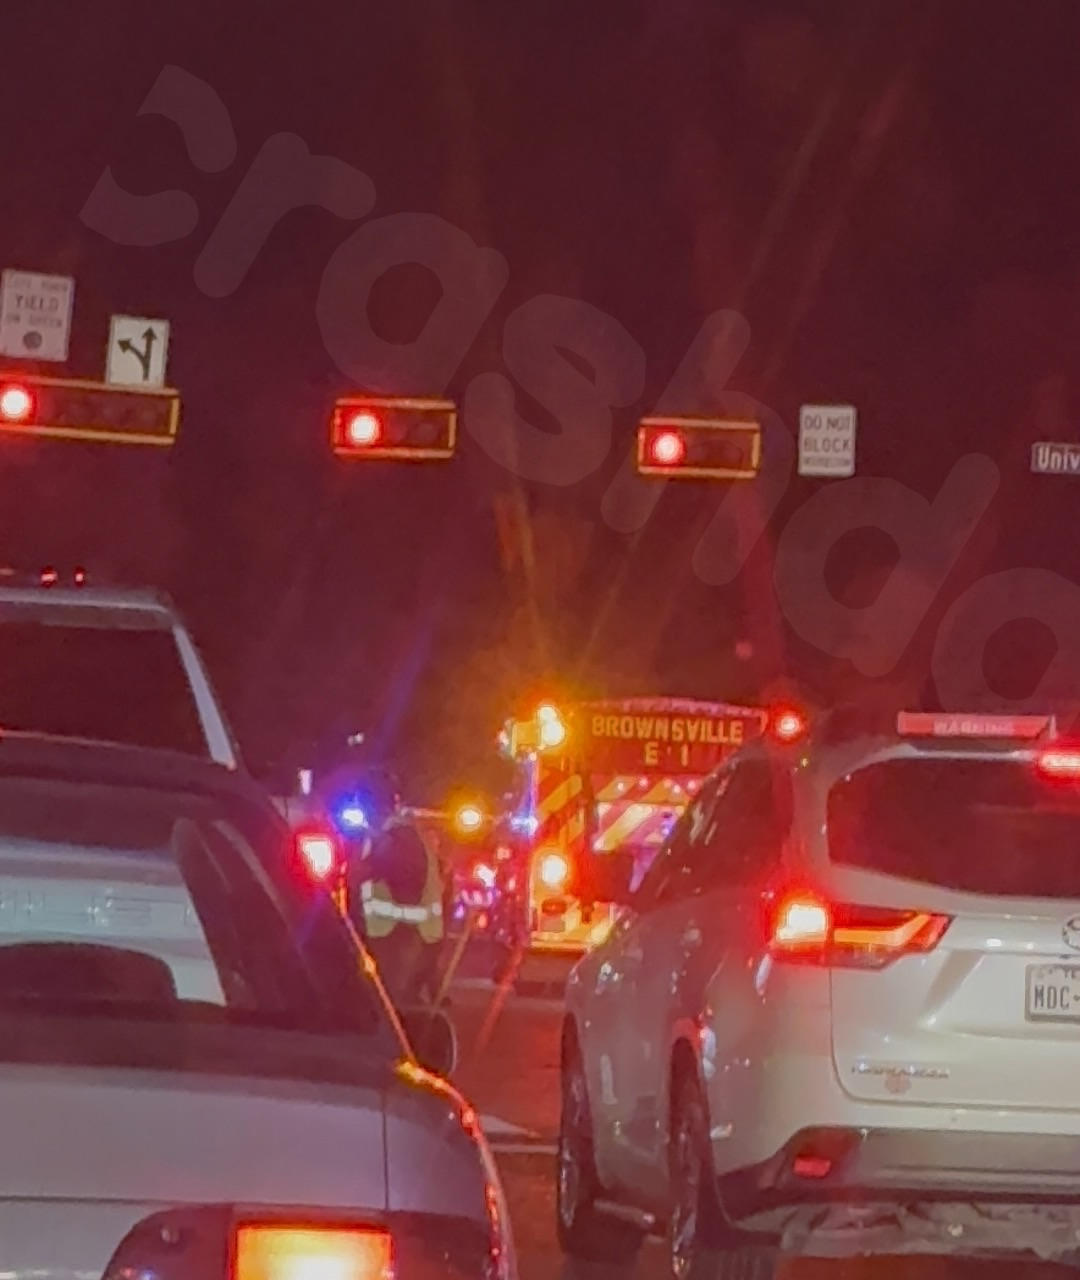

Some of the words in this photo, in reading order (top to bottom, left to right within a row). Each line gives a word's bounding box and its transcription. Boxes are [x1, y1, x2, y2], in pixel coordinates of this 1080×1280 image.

[804, 415, 822, 430] DO
[804, 437, 851, 453] BLOCK
[592, 716, 744, 746] BROWNSVILLE
